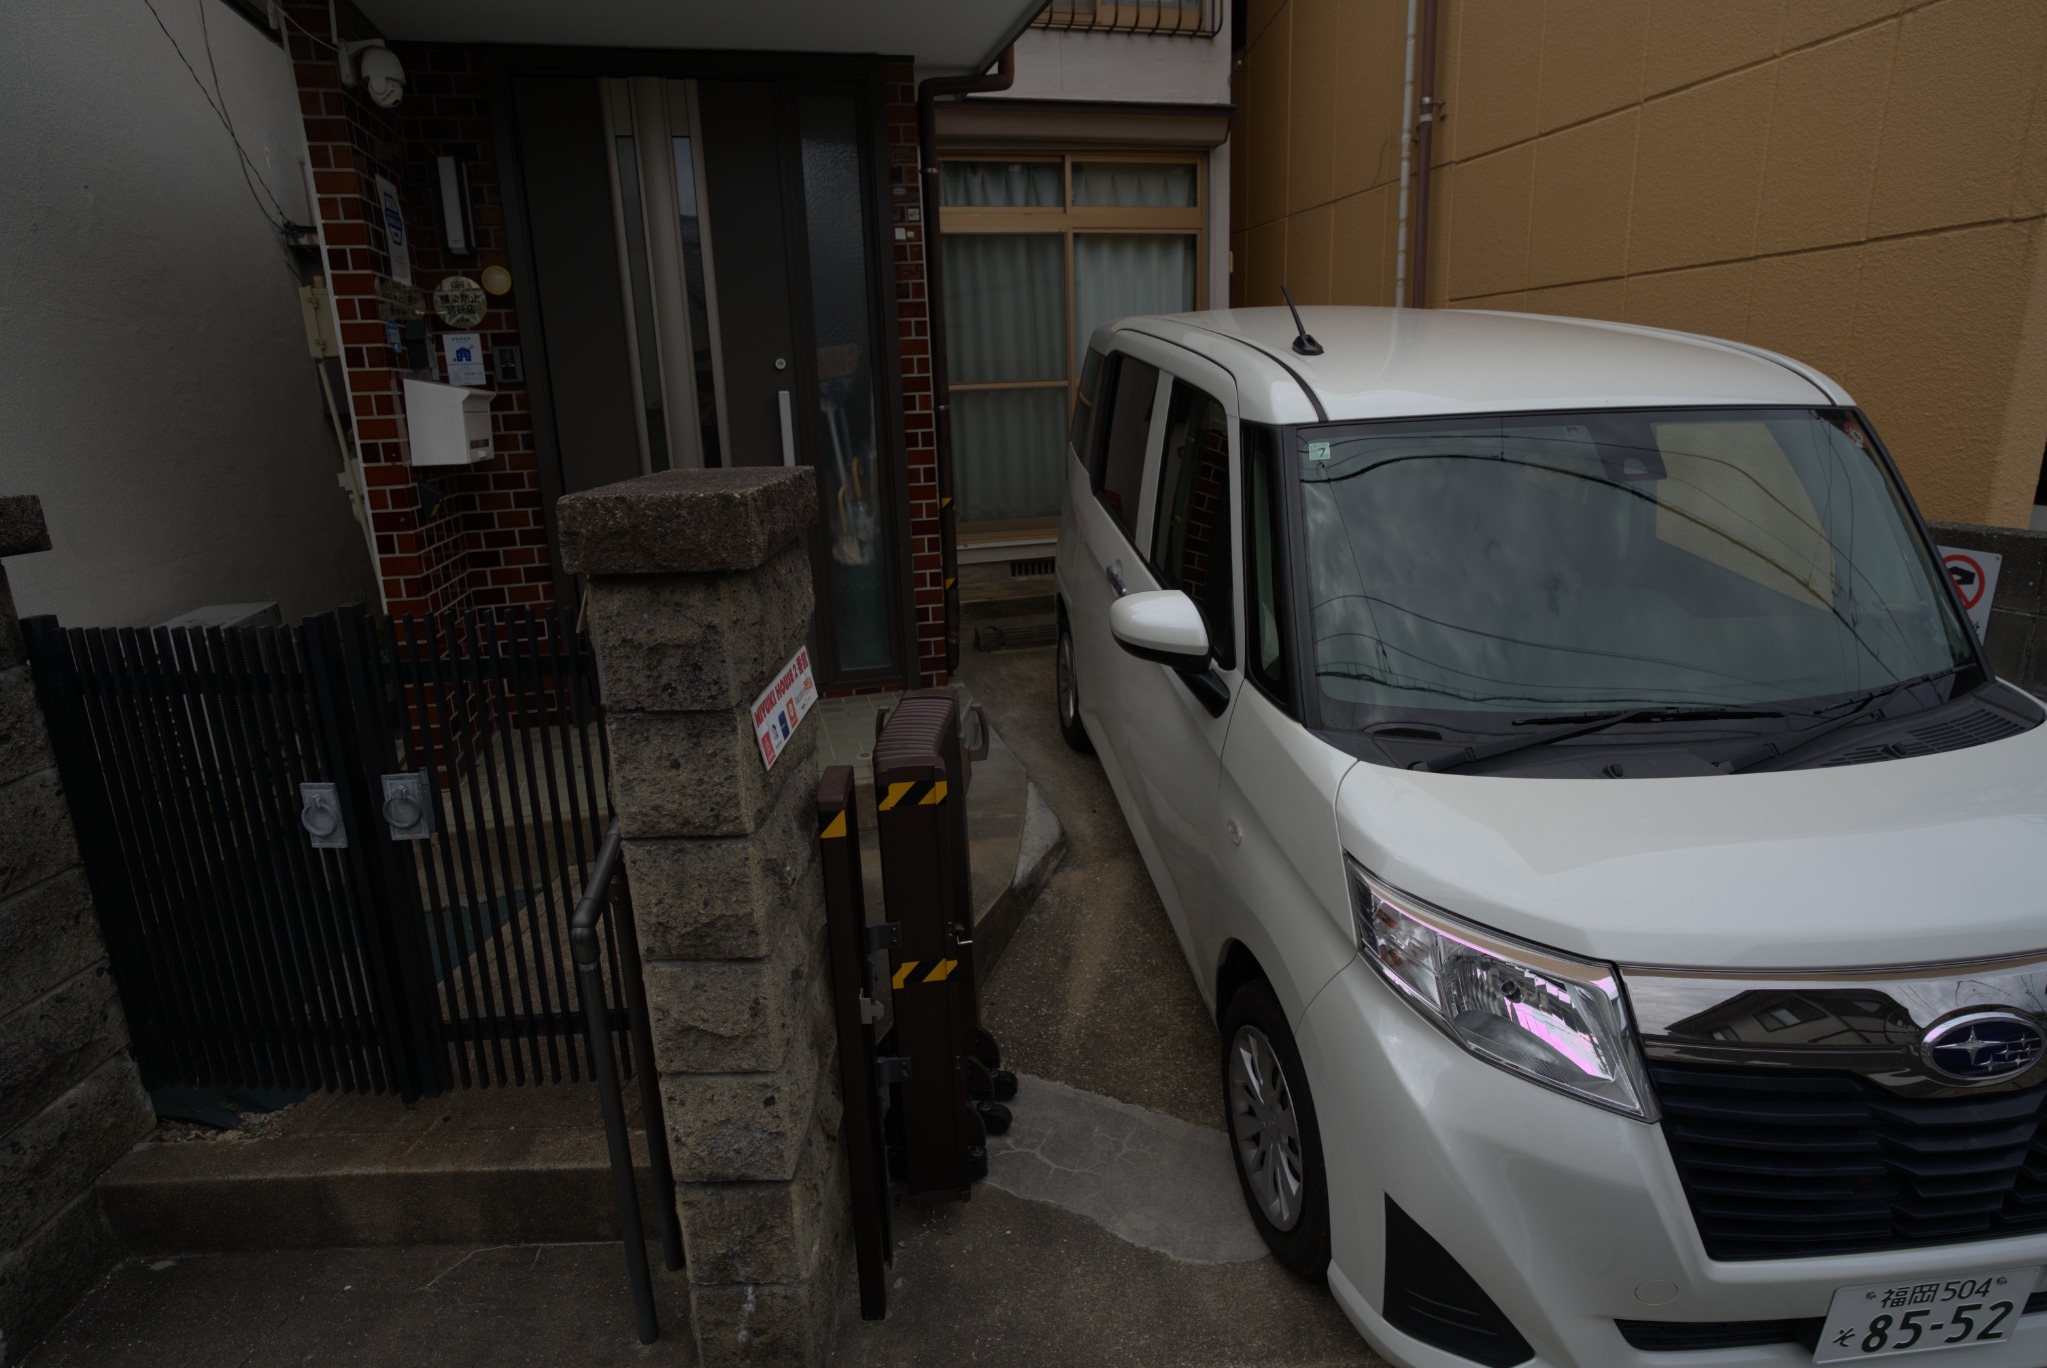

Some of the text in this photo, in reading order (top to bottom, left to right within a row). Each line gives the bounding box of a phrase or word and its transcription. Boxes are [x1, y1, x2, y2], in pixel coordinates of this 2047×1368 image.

[754, 689, 777, 728] MIYUKI
[774, 667, 794, 701] HOUSE
[1881, 1277, 1993, 1308] 福岡 504
[1833, 1301, 2014, 1353] そ 85-52
